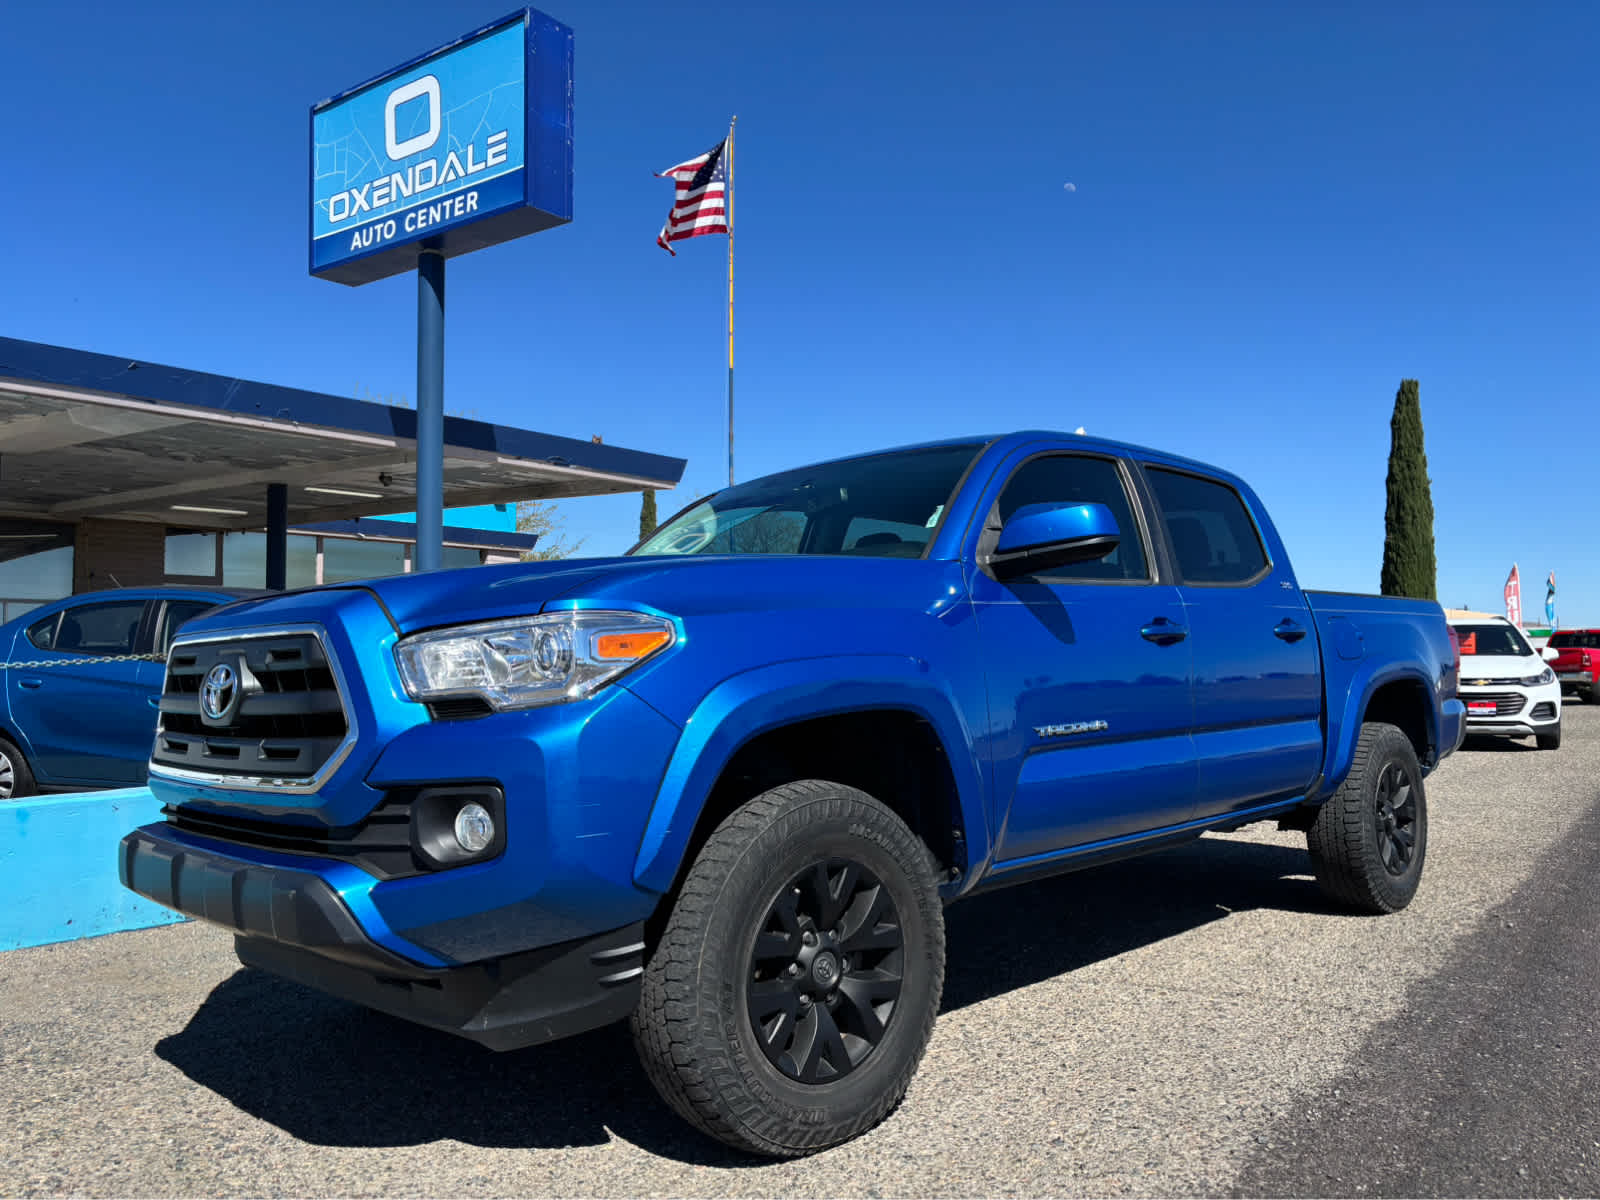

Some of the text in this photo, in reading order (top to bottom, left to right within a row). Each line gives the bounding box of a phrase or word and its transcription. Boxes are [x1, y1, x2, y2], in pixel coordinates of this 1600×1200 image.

[385, 75, 441, 161] O
[328, 129, 508, 224] OXENDALE
[350, 190, 479, 252] AUTO CENTER
[1033, 719, 1108, 737] TACOMA
